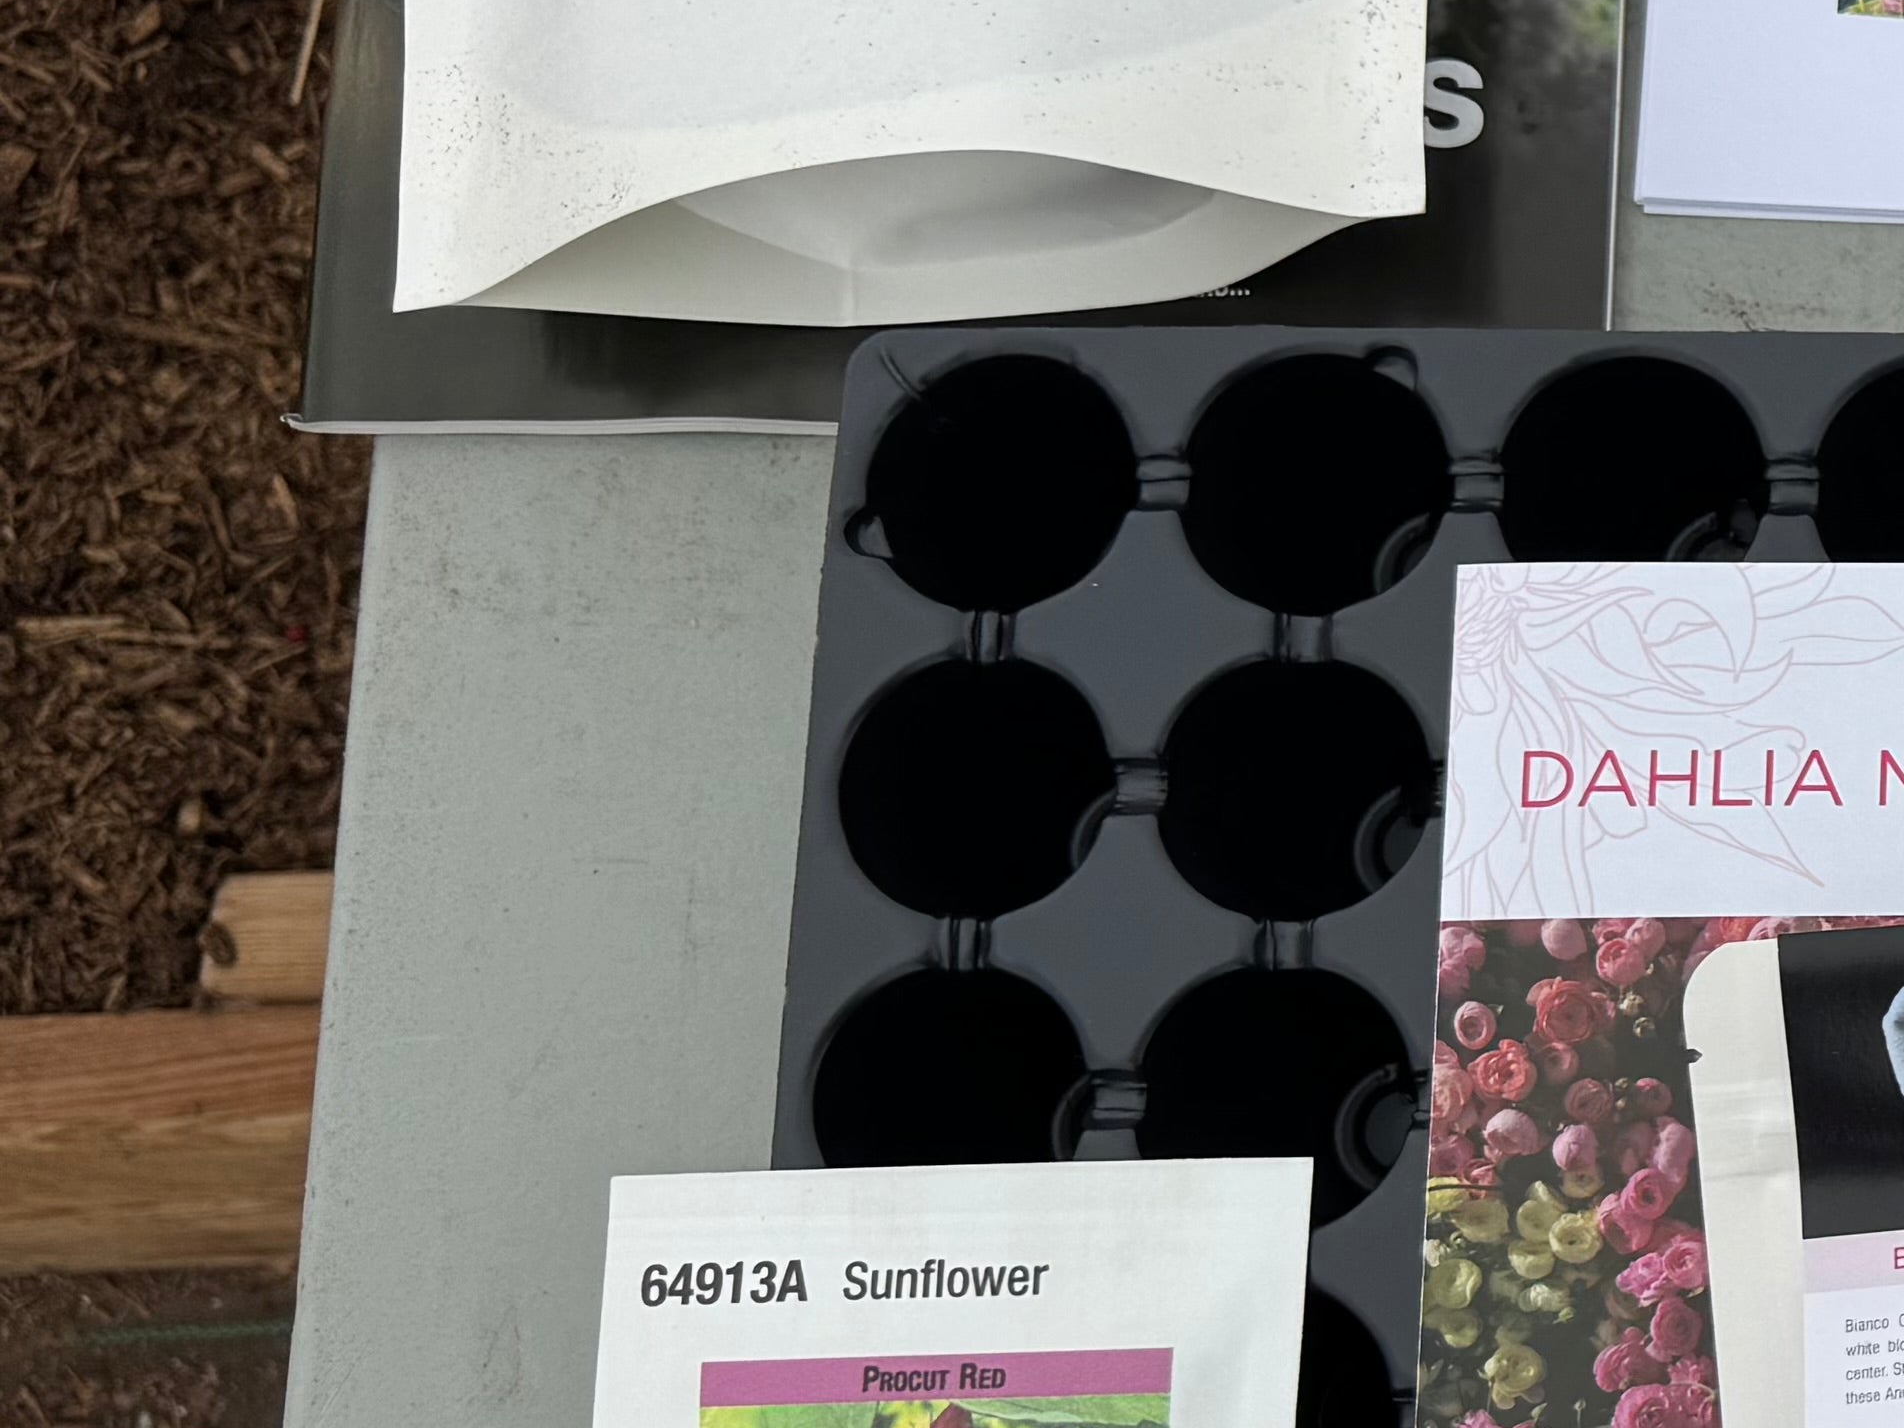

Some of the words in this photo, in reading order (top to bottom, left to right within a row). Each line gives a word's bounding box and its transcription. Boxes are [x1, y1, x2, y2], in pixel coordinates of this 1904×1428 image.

[1520, 747, 1844, 808] DAHLIA
[639, 1259, 809, 1308] 64913A
[842, 1258, 1050, 1303] Sunflower
[1845, 1317, 1890, 1333] Bianco
[1845, 1340, 1881, 1357] white
[861, 1362, 950, 1395] PROCUT
[957, 1359, 1007, 1392] RED
[1845, 1366, 1889, 1381] center.
[1845, 1390, 1881, 1405] these
